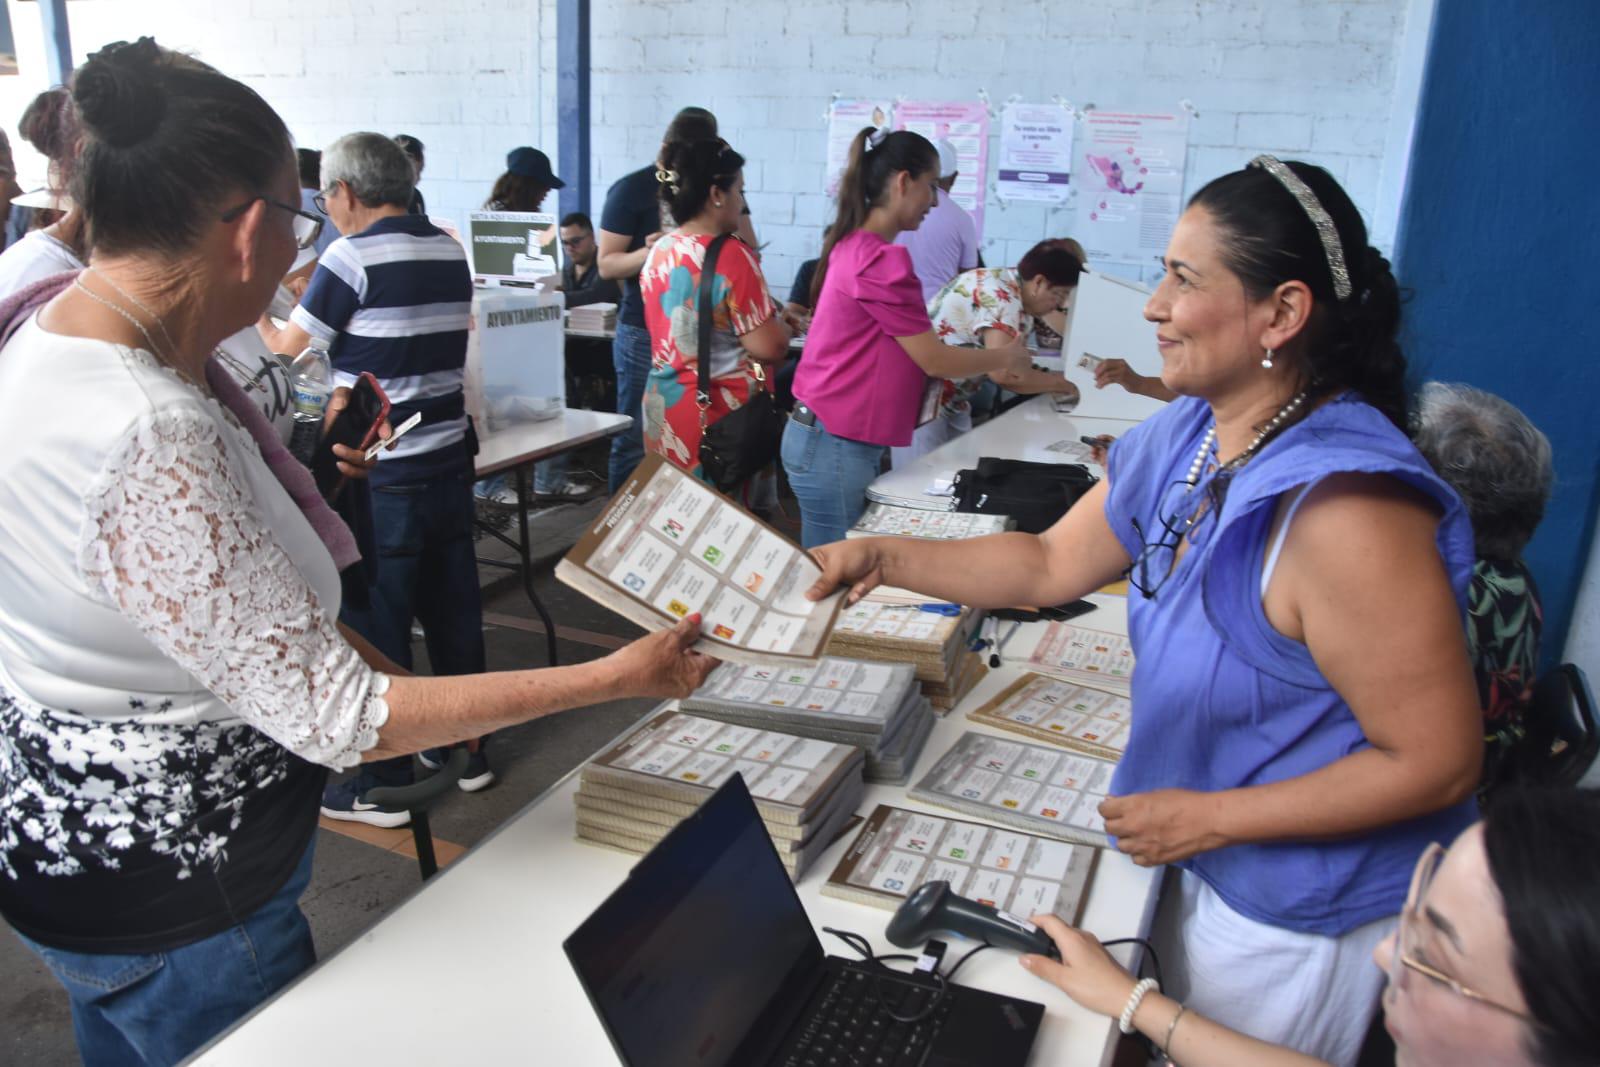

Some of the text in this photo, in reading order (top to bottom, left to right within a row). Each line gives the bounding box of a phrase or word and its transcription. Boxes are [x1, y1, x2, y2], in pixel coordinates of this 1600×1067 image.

[474, 235, 526, 245] AYUNTAMIENTO
[487, 304, 560, 328] AYUNTAMIENTO
[606, 493, 636, 529] PRESIDENCIA
